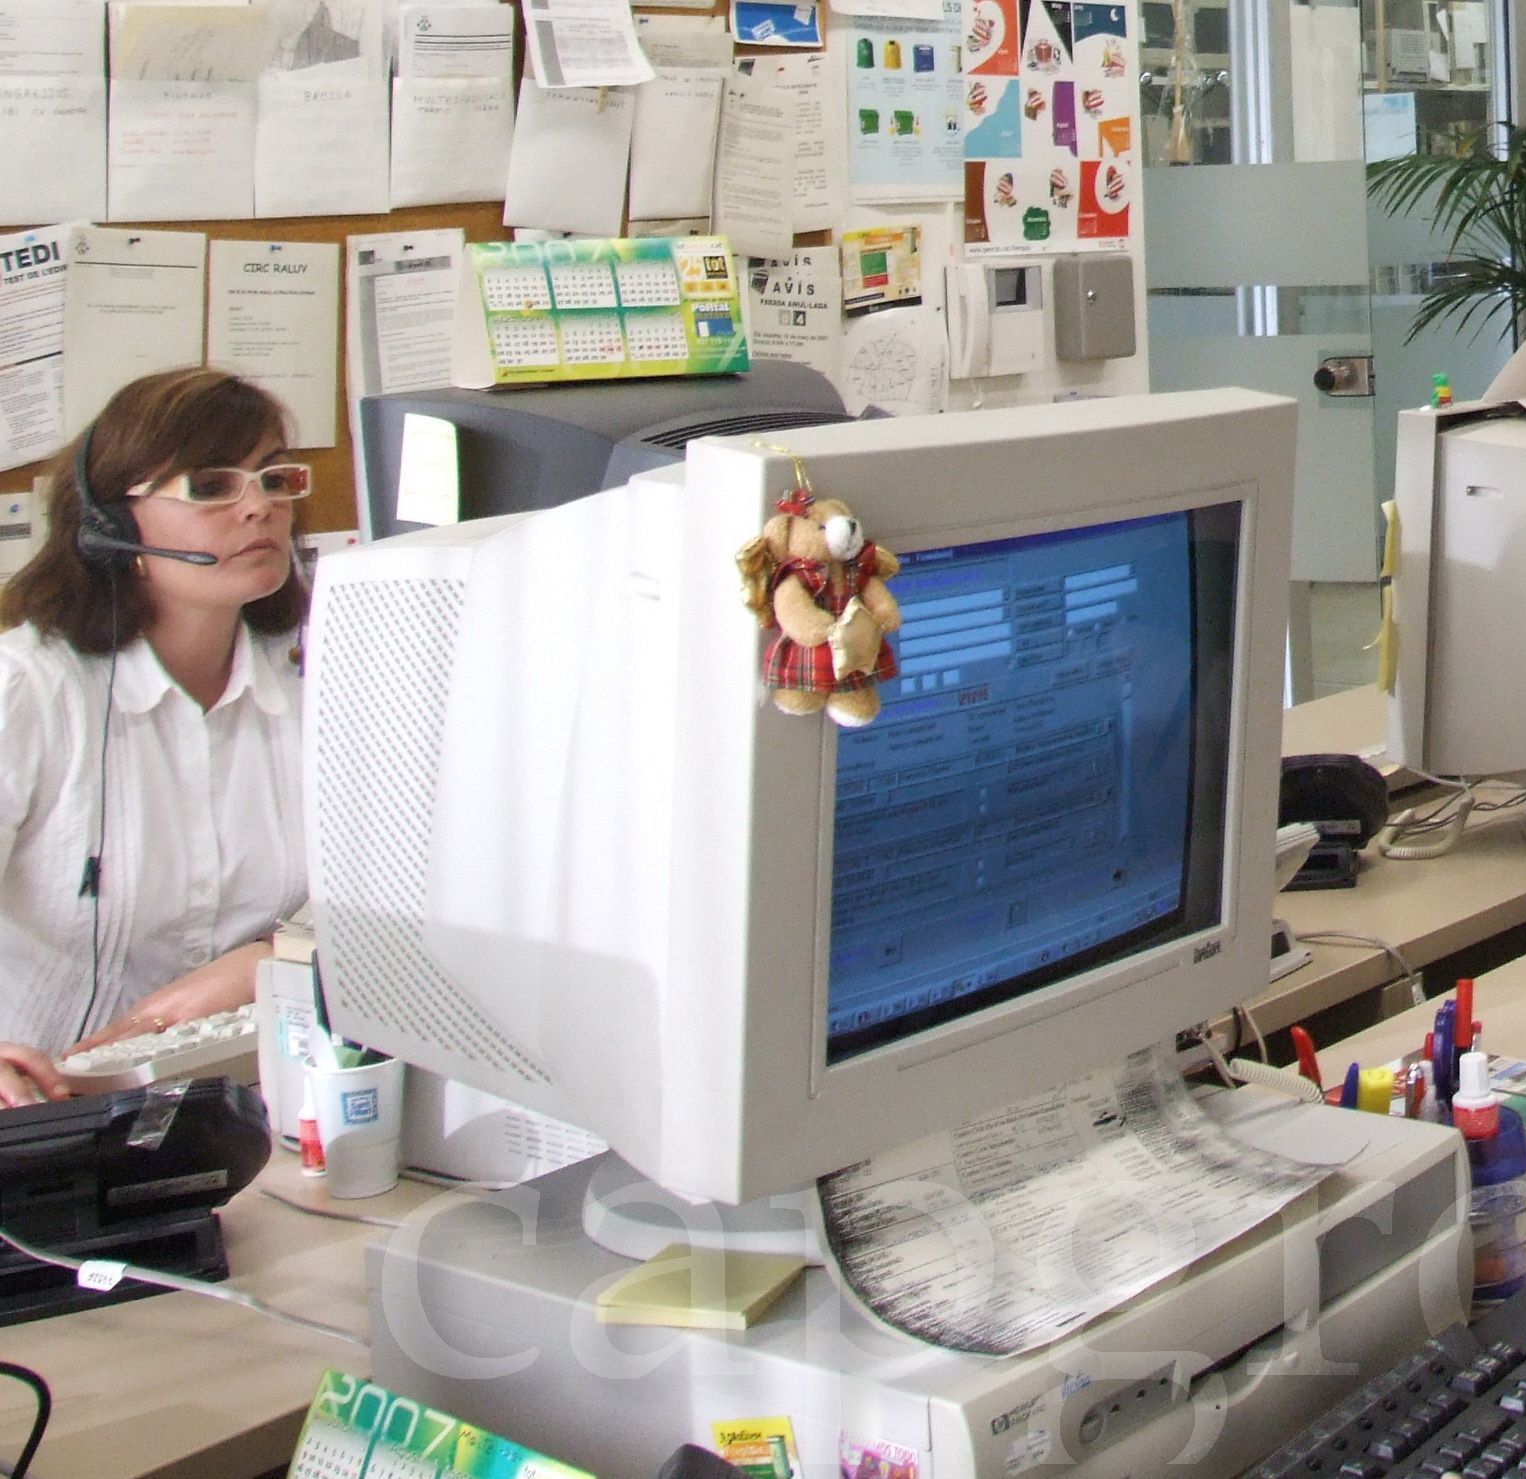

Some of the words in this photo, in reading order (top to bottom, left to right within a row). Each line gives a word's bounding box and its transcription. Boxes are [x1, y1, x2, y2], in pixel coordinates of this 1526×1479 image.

[0, 241, 60, 272] TEDI
[243, 263, 270, 272] CIRC
[314, 1373, 455, 1462] 2007
